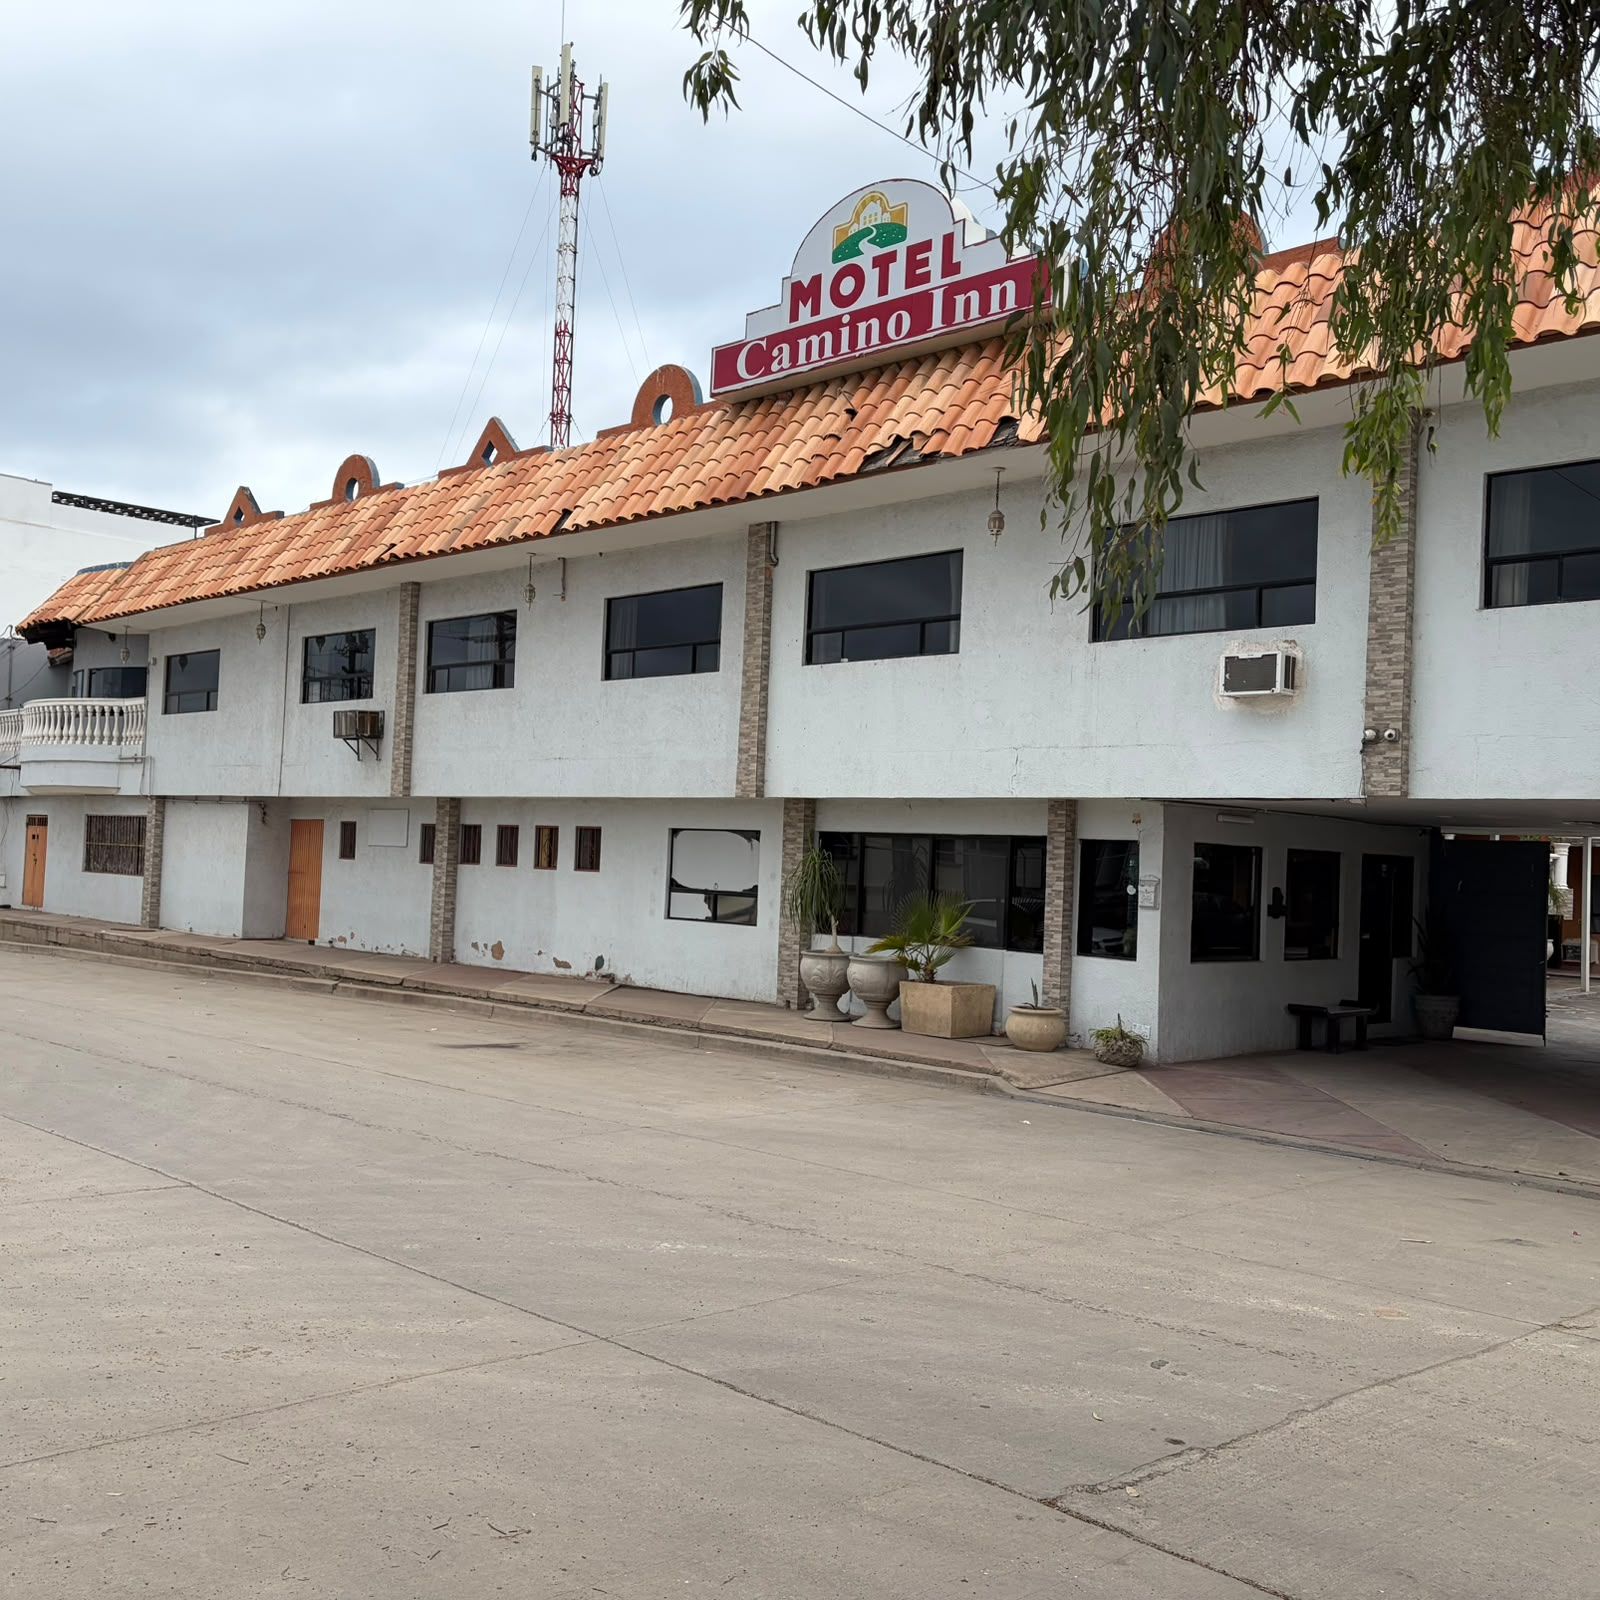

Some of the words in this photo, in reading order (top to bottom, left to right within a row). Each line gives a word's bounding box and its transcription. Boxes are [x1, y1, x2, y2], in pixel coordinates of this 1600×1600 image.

[789, 232, 961, 324] MOTEL
[737, 310, 911, 380] Camino
[928, 279, 1018, 330] Inn
